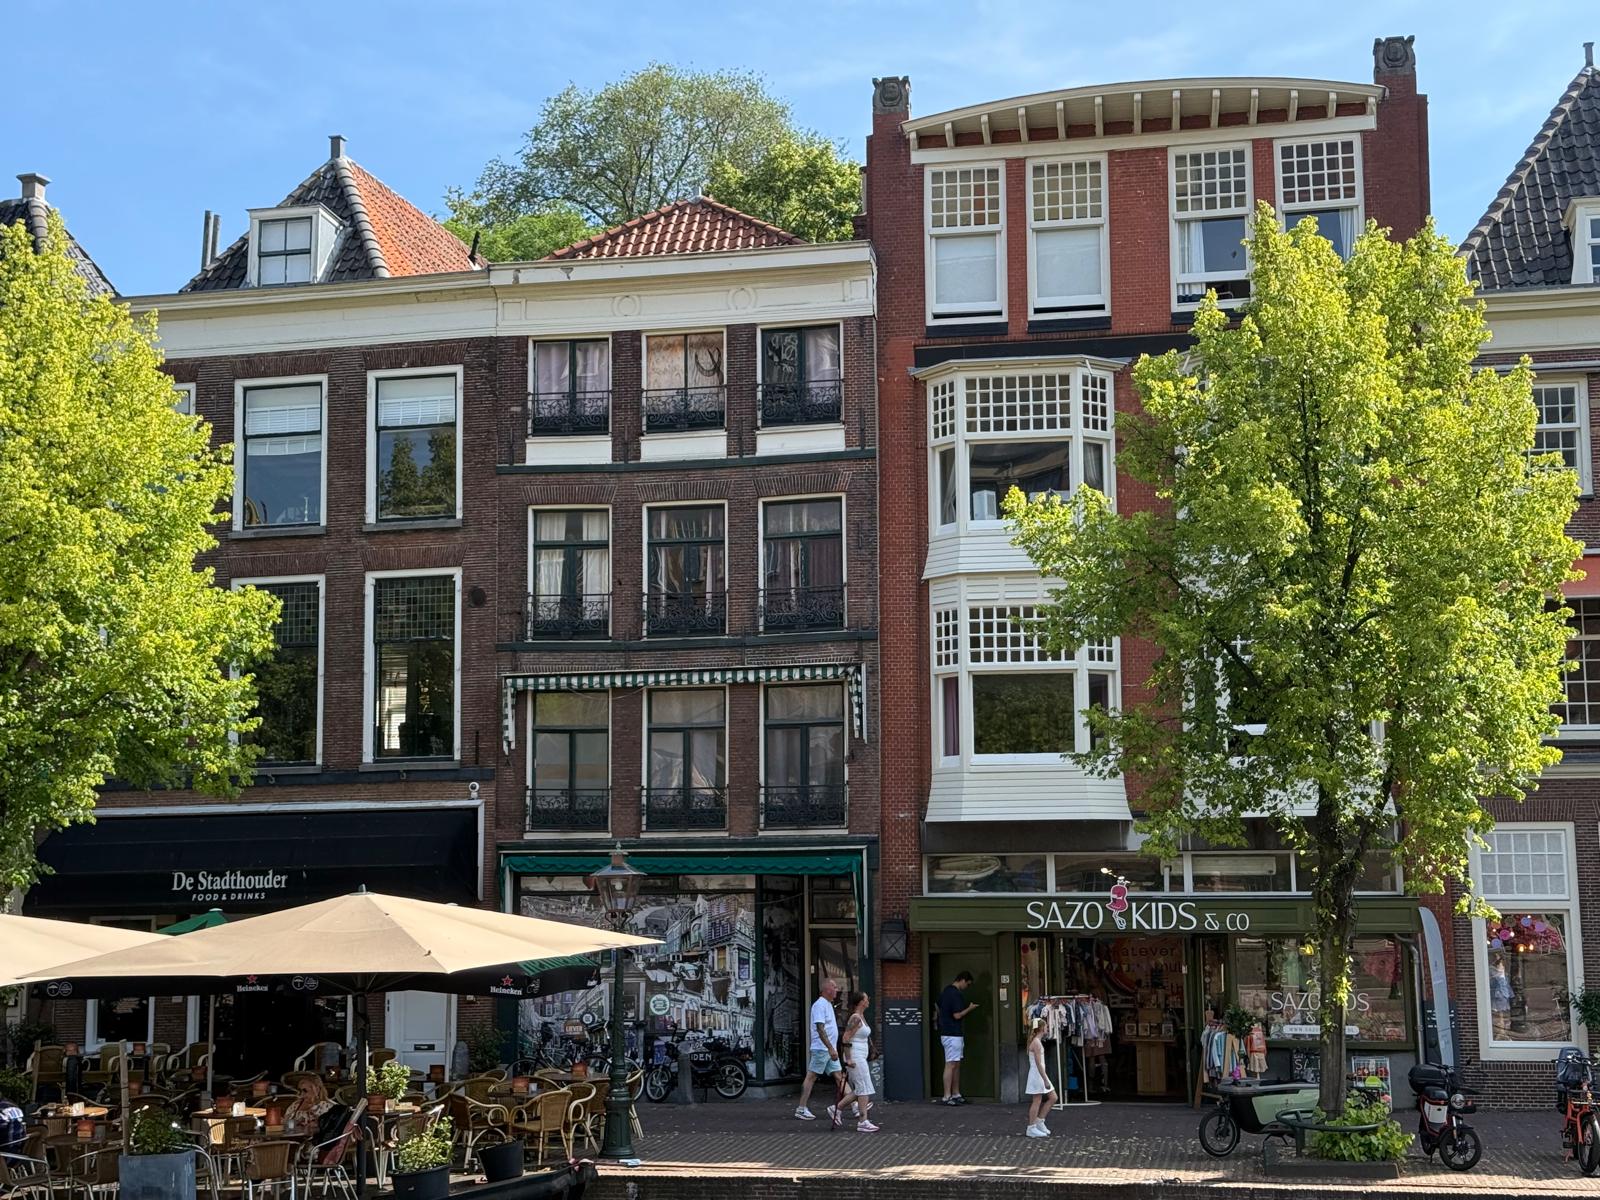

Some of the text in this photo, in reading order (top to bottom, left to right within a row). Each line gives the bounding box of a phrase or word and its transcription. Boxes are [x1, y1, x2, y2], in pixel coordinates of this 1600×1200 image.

[171, 869, 288, 891] De Stadthouder
[192, 892, 266, 901] FOOD & DRINKS
[1026, 901, 1250, 931] SAZO KIDS & CO
[236, 984, 268, 993] Heineken
[490, 986, 522, 996] Heineken
[1271, 992, 1320, 1011] SAZO
